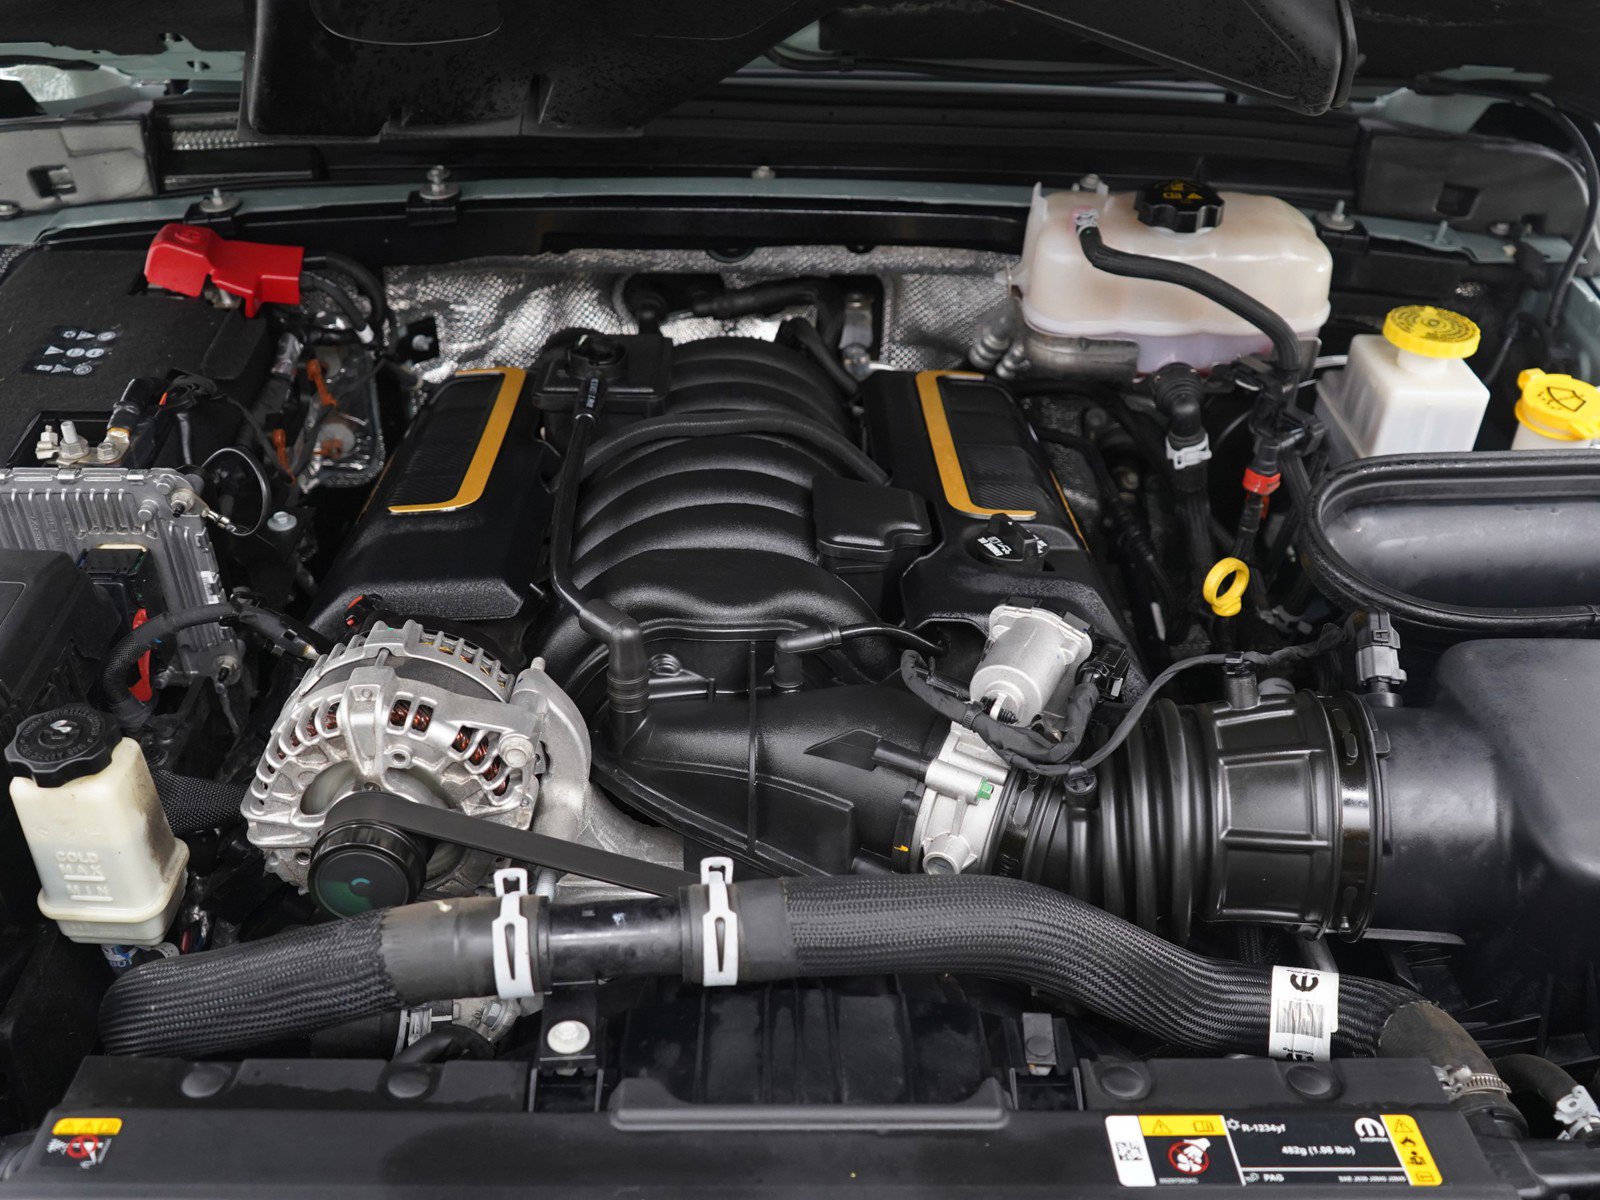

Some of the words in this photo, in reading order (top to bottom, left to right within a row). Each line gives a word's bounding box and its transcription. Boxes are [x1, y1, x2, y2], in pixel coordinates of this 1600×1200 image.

[56, 851, 98, 863] COLD
[59, 864, 104, 875] MAX
[66, 884, 109, 895] MIN
